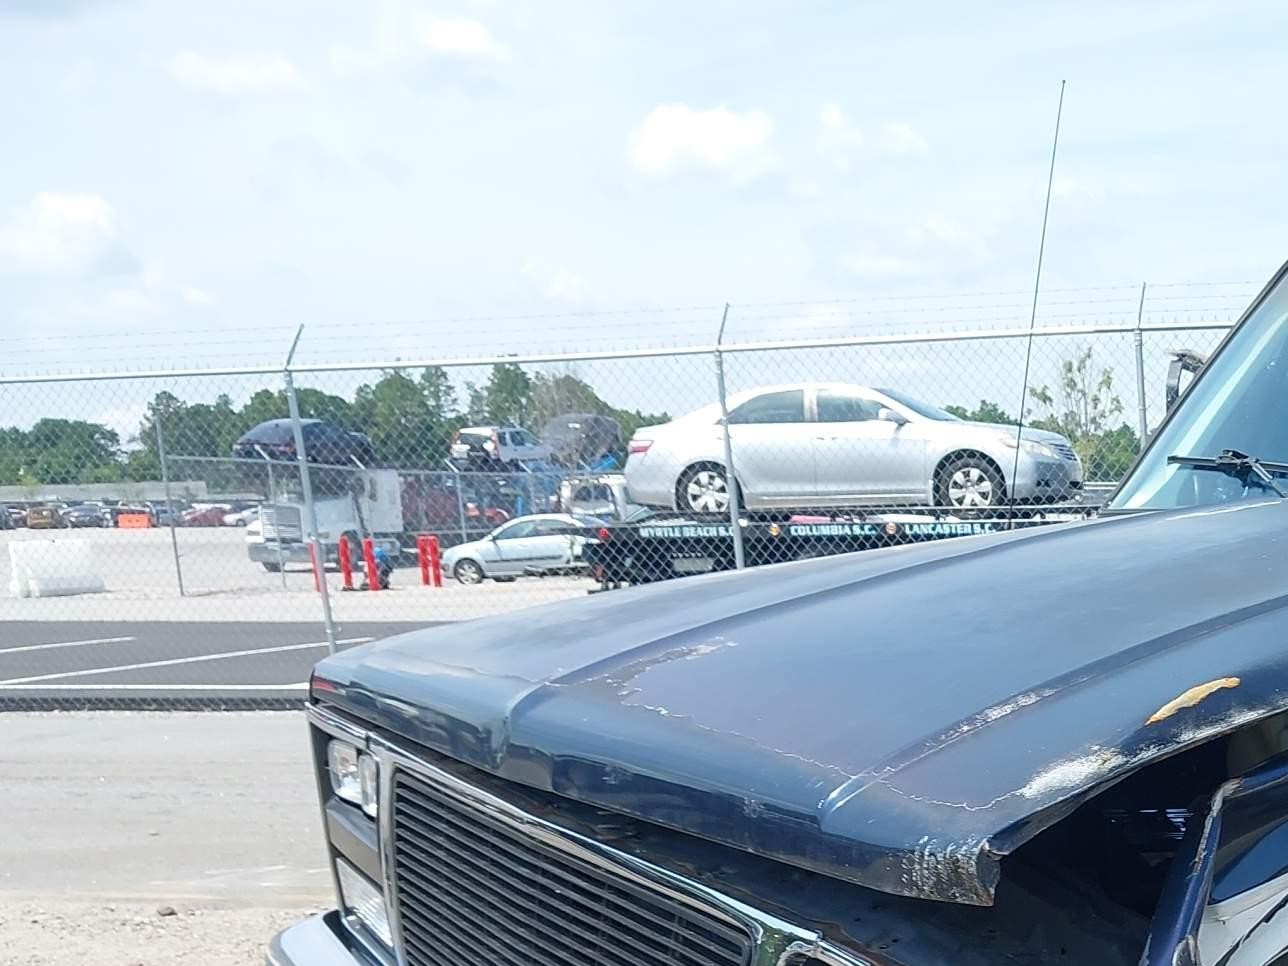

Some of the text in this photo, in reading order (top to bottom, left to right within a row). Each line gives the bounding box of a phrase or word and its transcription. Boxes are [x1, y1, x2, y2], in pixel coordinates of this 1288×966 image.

[639, 526, 682, 538] MYRTLE
[683, 526, 717, 538] BEACH
[790, 524, 877, 536] COLUMBIA S.C.
[905, 523, 972, 535] LANCASTER
